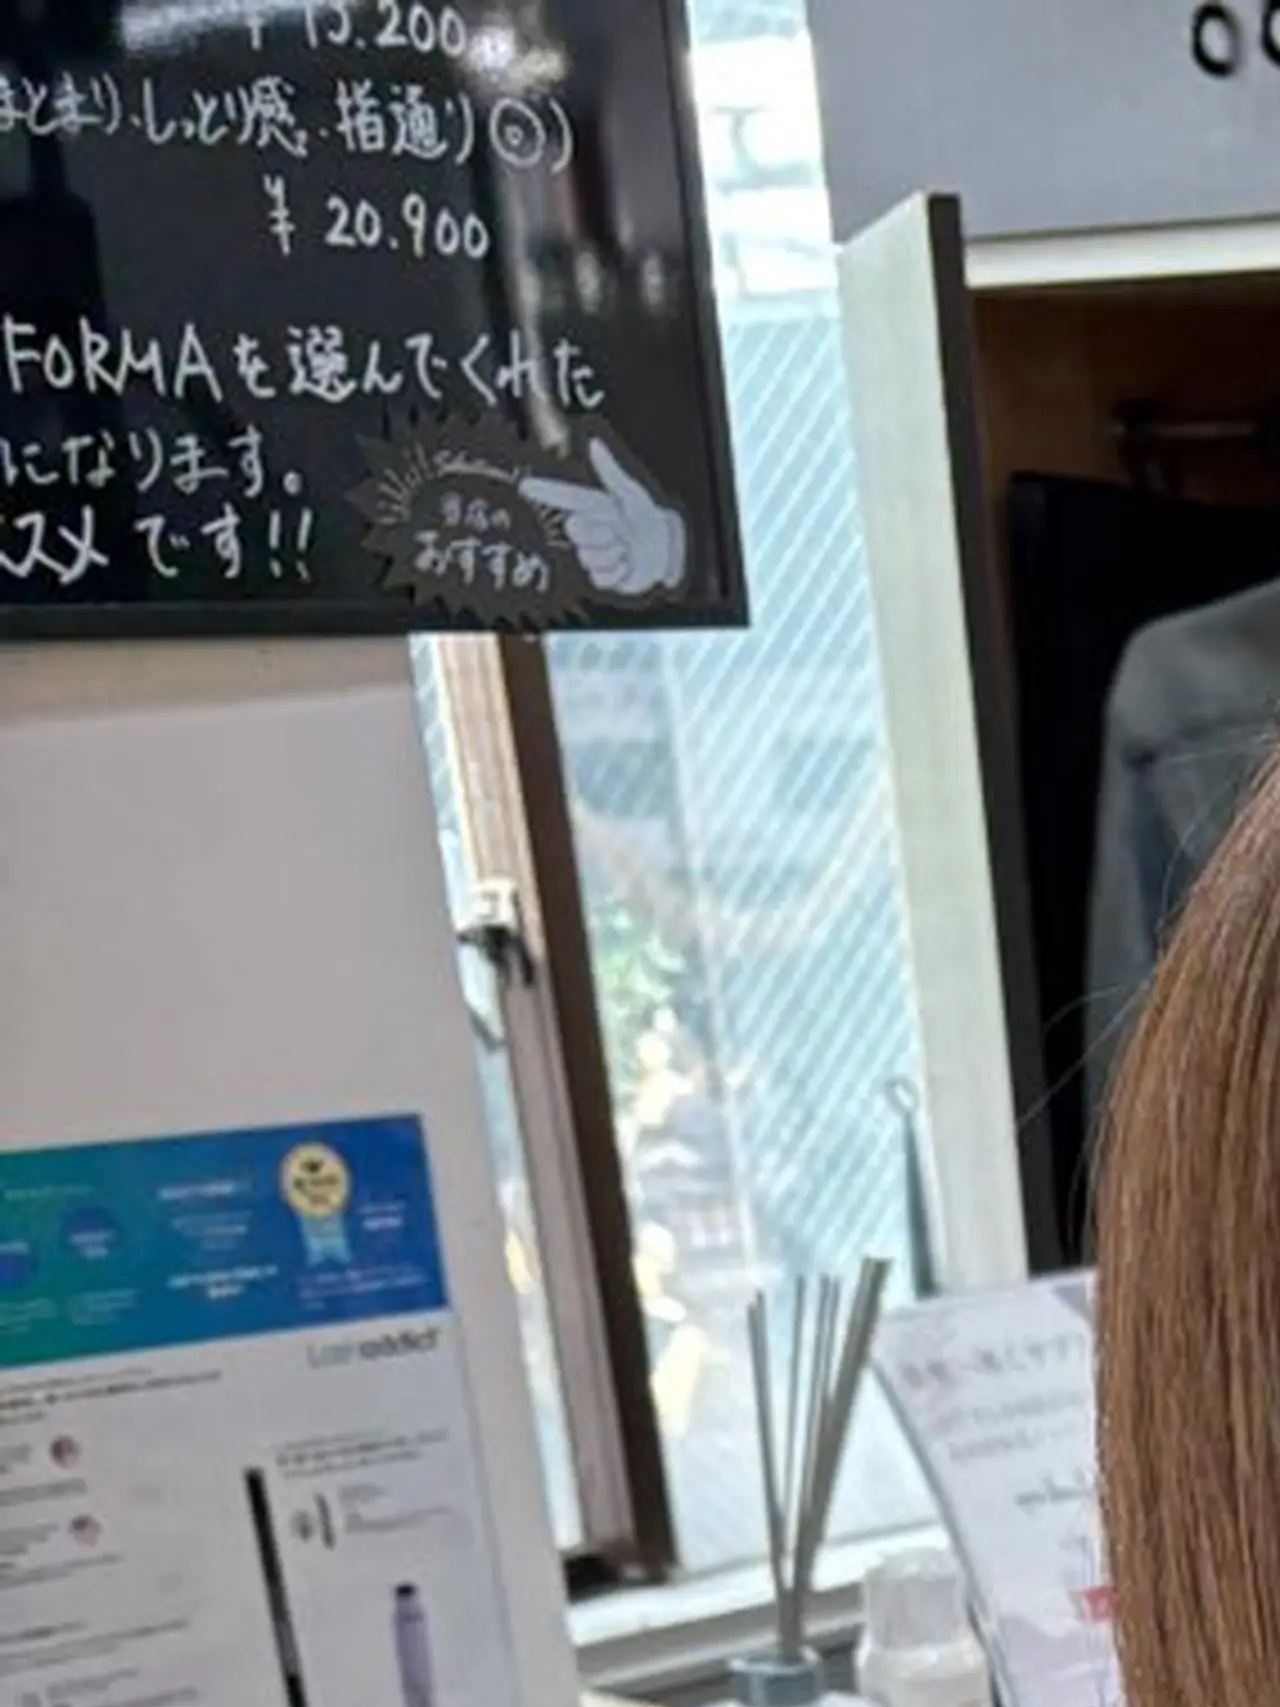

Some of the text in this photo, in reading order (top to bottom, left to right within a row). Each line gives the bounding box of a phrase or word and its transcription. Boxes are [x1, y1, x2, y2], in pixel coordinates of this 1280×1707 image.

[0, 423, 303, 498] になります。
[412, 529, 550, 593] おすすめ
